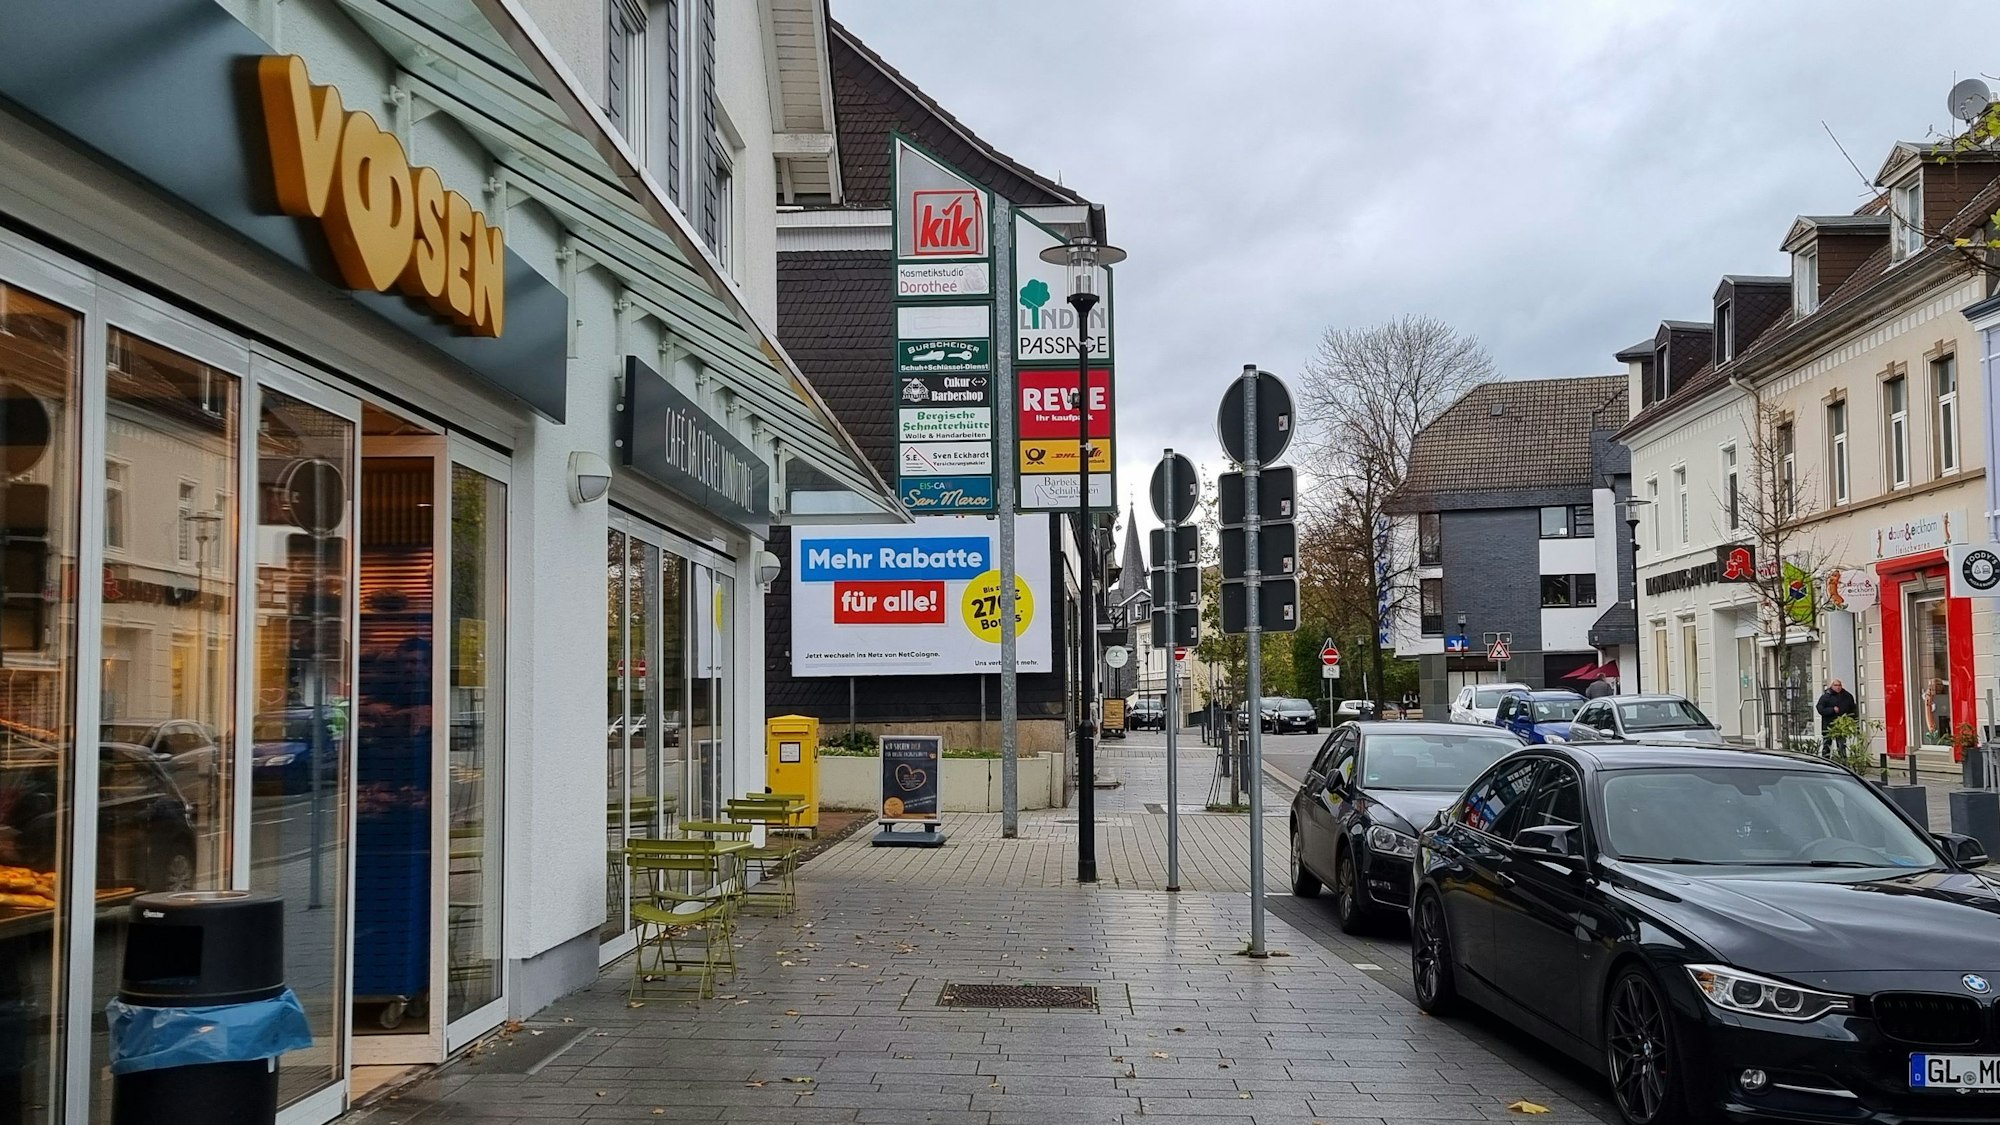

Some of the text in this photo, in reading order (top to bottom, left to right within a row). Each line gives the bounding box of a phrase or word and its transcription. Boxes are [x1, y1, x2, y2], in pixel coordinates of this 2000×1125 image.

[900, 267, 964, 278] Kosmetikstudio
[1020, 307, 1106, 330] LINDN
[907, 341, 980, 355] BURSCHEIDER
[931, 390, 984, 402] Barbershop
[917, 411, 976, 422] Bergische
[903, 421, 990, 431] Schnatterhütte
[954, 451, 990, 459] Eckhardt
[1049, 486, 1099, 495] Schuhlen
[902, 489, 990, 507] San Marco
[808, 547, 983, 569] Mehr Rabatte
[1966, 552, 1998, 566] FOODY'S
[841, 590, 938, 612] für alle!
[1915, 1073, 1921, 1081] D
[1928, 1059, 1961, 1083] GL
